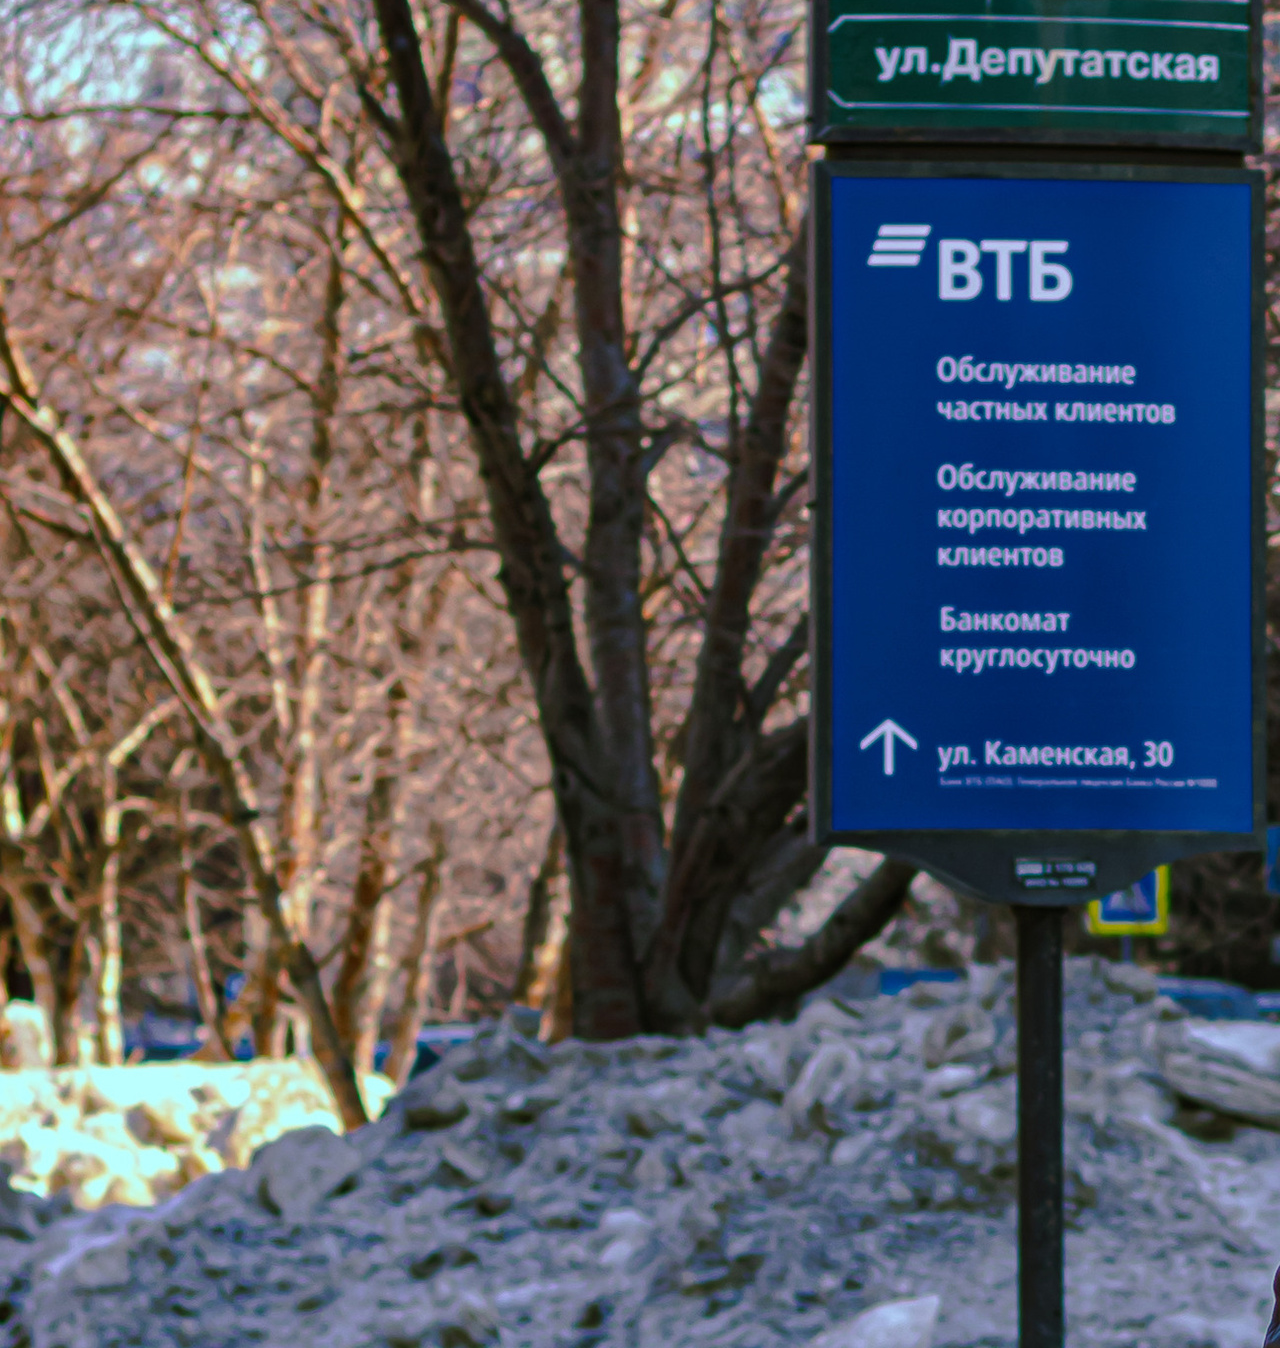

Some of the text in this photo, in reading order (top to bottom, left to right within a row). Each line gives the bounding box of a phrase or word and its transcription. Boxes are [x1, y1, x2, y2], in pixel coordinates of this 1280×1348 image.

[875, 38, 1220, 84] ул.Депутатская
[938, 239, 1073, 302] ВТБ
[936, 355, 1136, 390] Обслуживание
[937, 400, 1176, 424] частных клиентов
[937, 463, 1137, 497] Обслуживание
[937, 508, 1147, 535] корпоративных
[937, 546, 1064, 567] клиентов
[940, 606, 1071, 632] Банкомат
[940, 648, 1136, 674] круглосуточно
[937, 740, 1174, 772] ул. Каменская, 30
